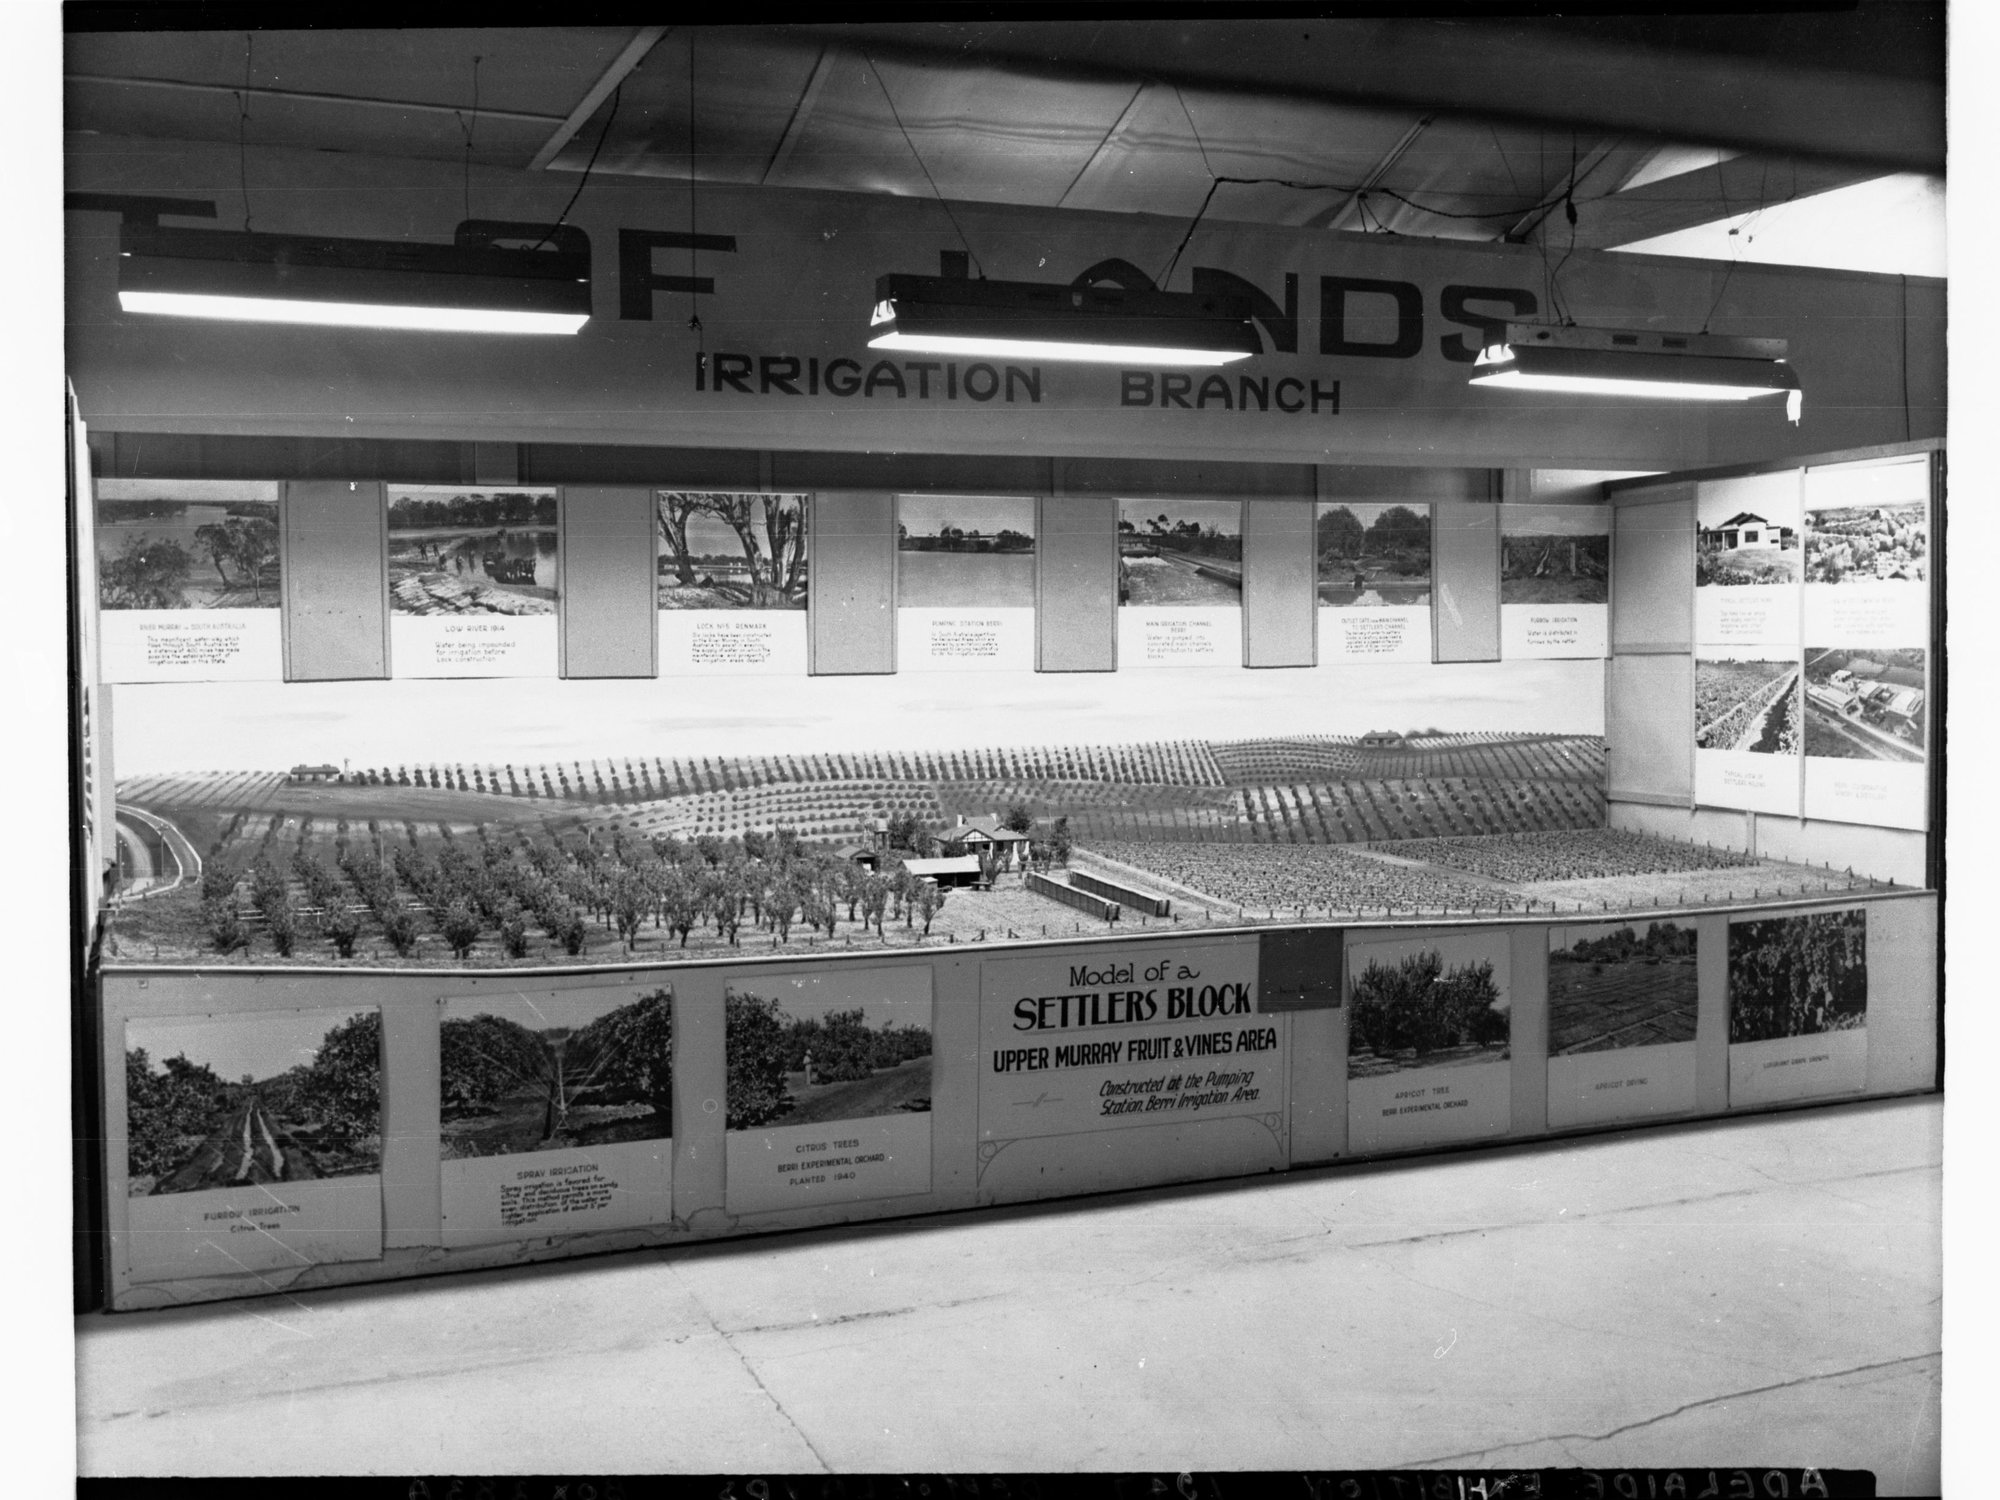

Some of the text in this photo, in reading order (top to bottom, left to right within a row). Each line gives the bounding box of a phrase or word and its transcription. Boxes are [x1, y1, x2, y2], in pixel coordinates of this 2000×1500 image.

[696, 351, 1341, 415] IRRIGATION BRANCH
[445, 624, 464, 632] LOW
[467, 624, 487, 632] RIVER
[1069, 960, 1200, 987] Model of a
[1012, 982, 1252, 1031] SETTLERS BLOCK
[993, 1026, 1278, 1073] UPPER MURRAY FRUIT & VINES AREA
[1100, 1068, 1255, 1097] Constructed at the Pumping
[1595, 1080, 1623, 1090] APRICOT
[1145, 1093, 1178, 1111] Berri
[1178, 1089, 1229, 1111] Irrigation
[1395, 1086, 1450, 1099] APRICOT TREE
[1399, 1102, 1441, 1114] EXPERIMENTAL
[1443, 1099, 1469, 1109] ORCHARD
[795, 1139, 860, 1153] CITRUS TREES
[777, 1153, 885, 1173] BERRI EXPERIMENTAL ORCHARD
[516, 1164, 599, 1180] SPRAY IRRIGATION
[789, 1171, 857, 1186] PLANTED 1940
[501, 1184, 522, 1194] Spray
[524, 1181, 554, 1193] irrigation
[203, 1205, 300, 1221] FURROW IRRIGATION
[230, 1222, 281, 1233] Citrus Trees
